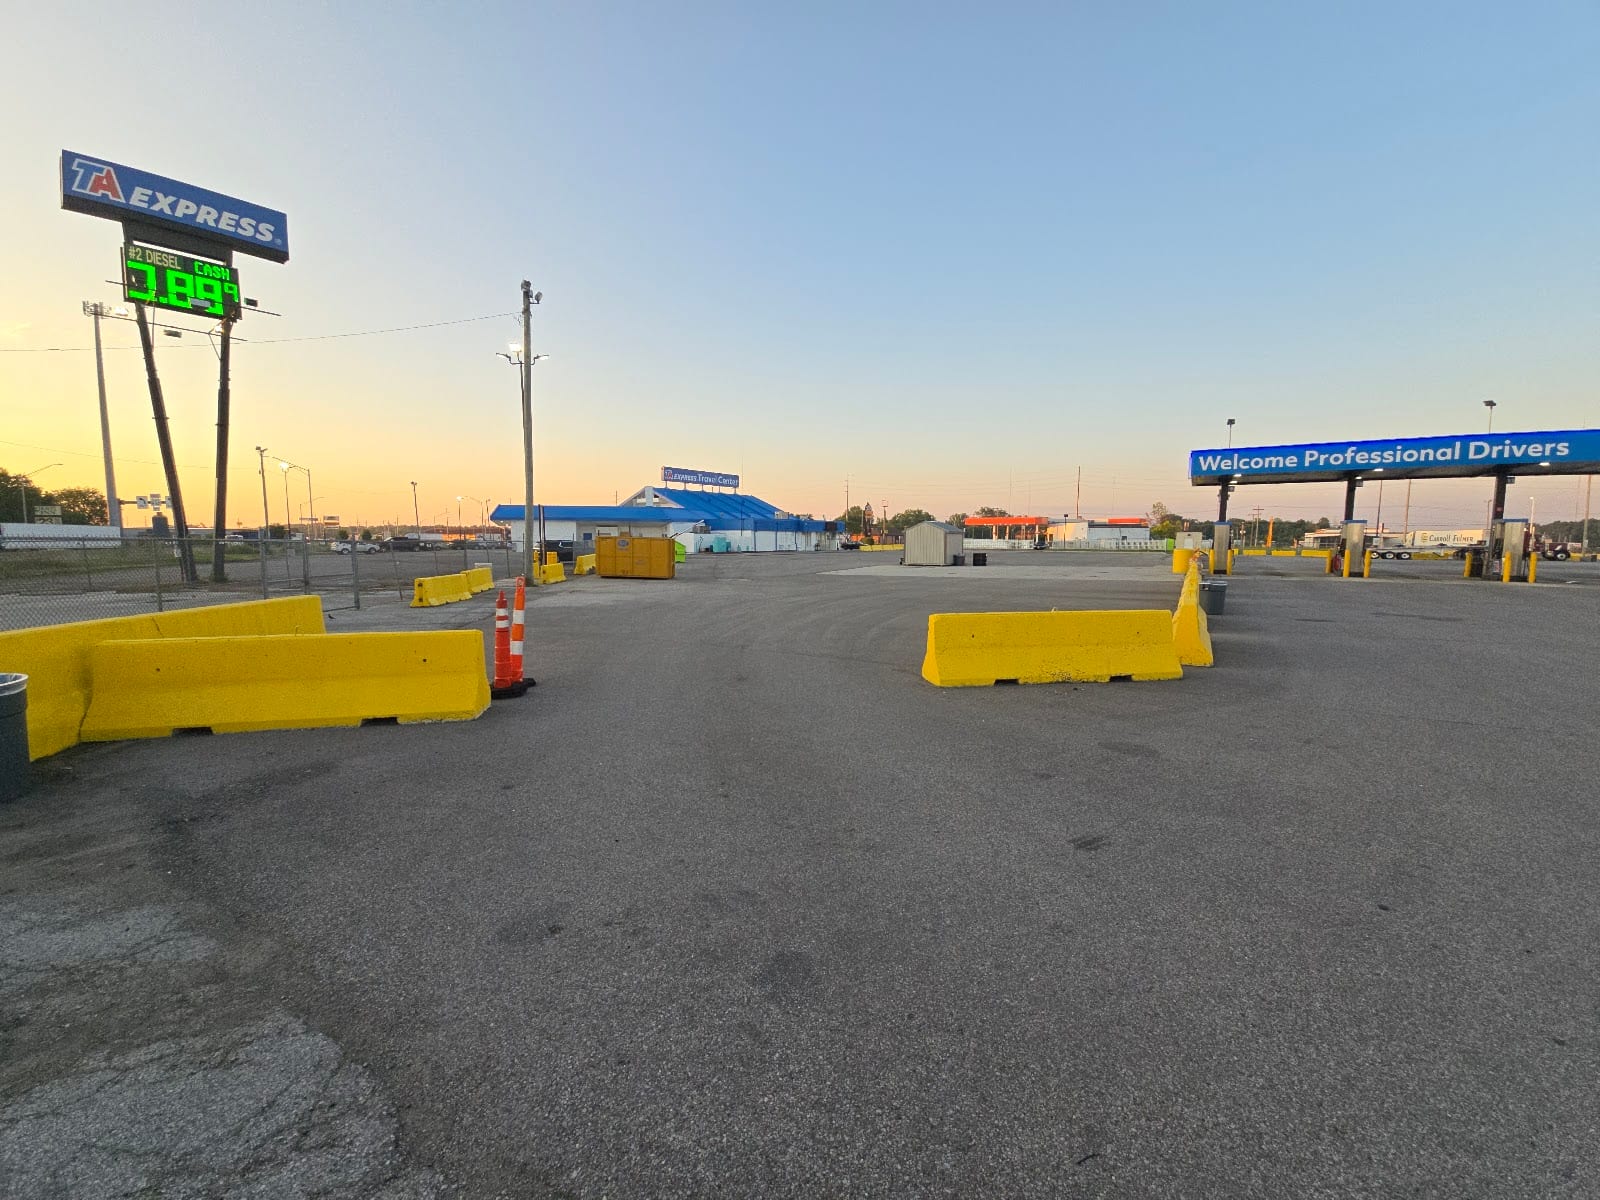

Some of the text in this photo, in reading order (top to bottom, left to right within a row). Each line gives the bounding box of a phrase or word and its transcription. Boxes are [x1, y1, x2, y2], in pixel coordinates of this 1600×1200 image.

[72, 158, 276, 242] TA EXPRESS
[128, 246, 182, 270] #2 DIESEL
[193, 260, 230, 281] CASH
[1199, 439, 1570, 471] Welcome Professional Drivers
[697, 473, 717, 484] Travel
[717, 476, 738, 486] Center
